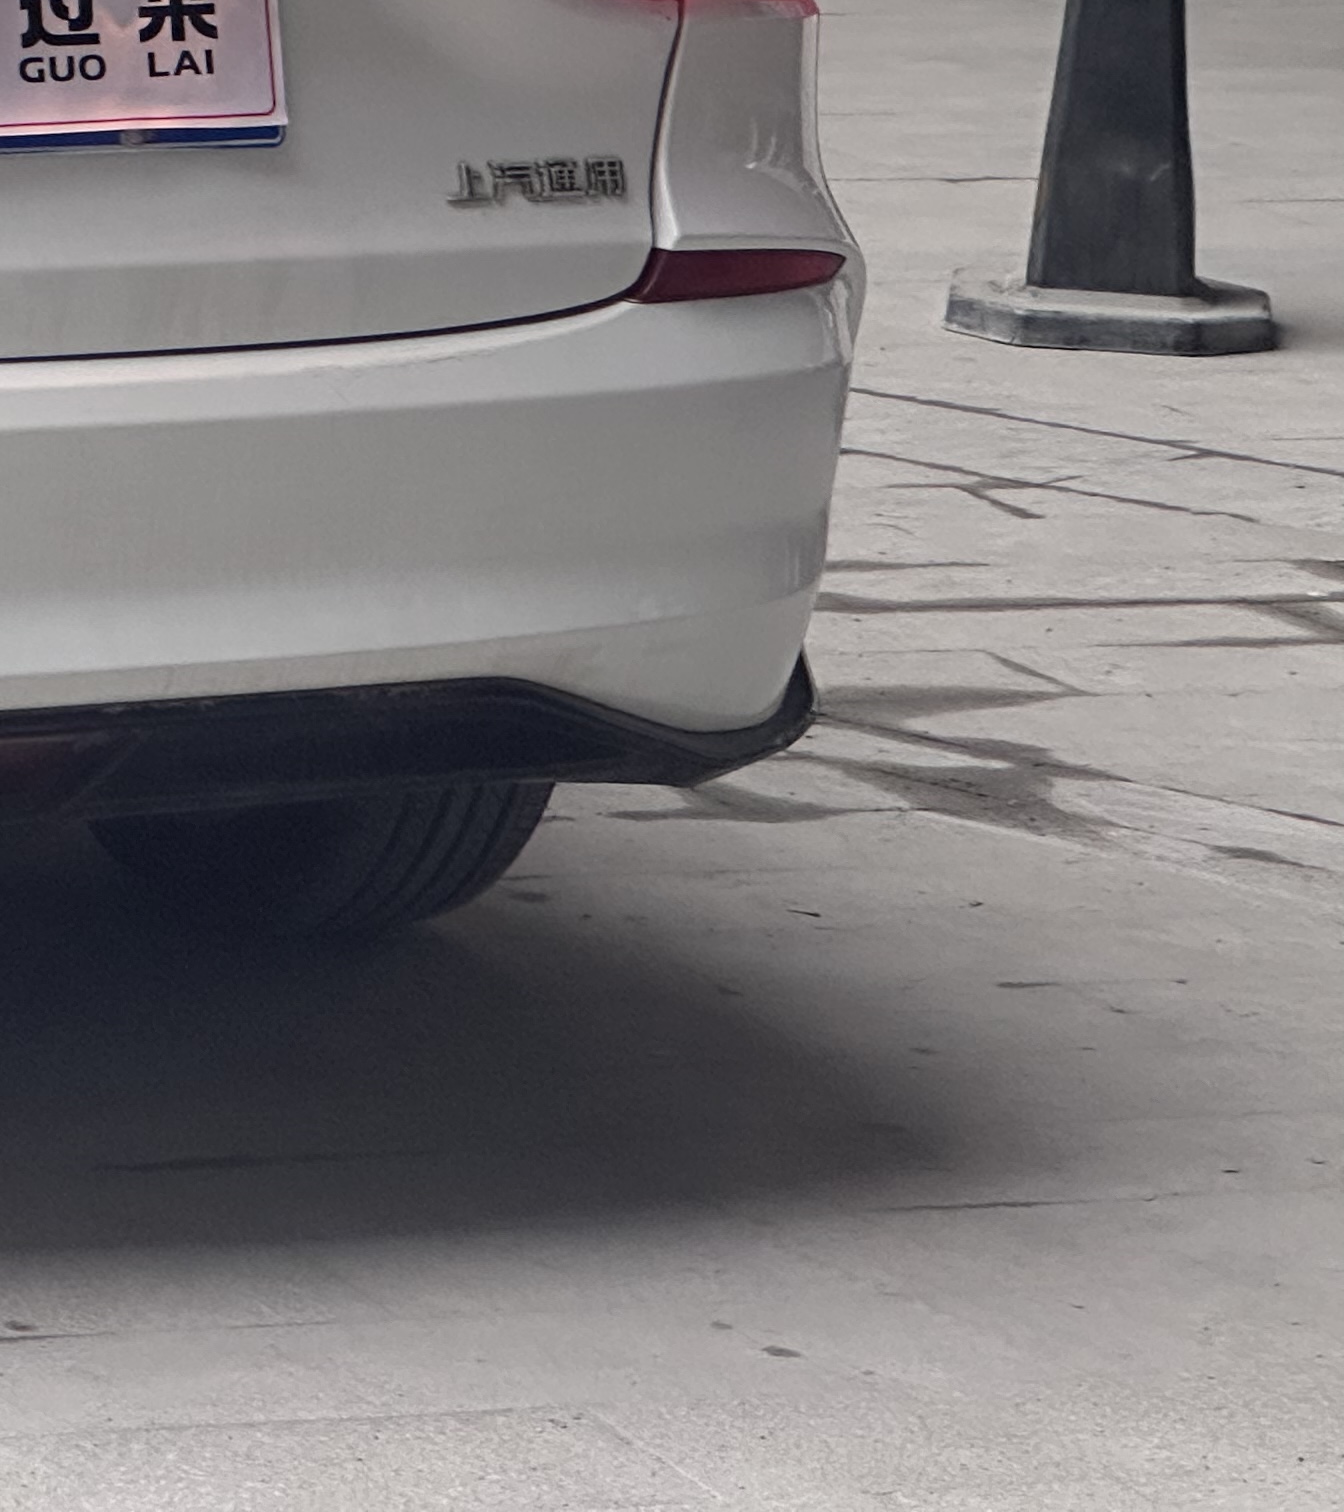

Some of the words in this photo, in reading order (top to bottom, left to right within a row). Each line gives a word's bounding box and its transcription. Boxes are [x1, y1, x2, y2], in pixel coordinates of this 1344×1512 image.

[18, 52, 107, 84] GUO
[147, 48, 215, 78] LAI
[446, 156, 627, 207] 上汽通用
